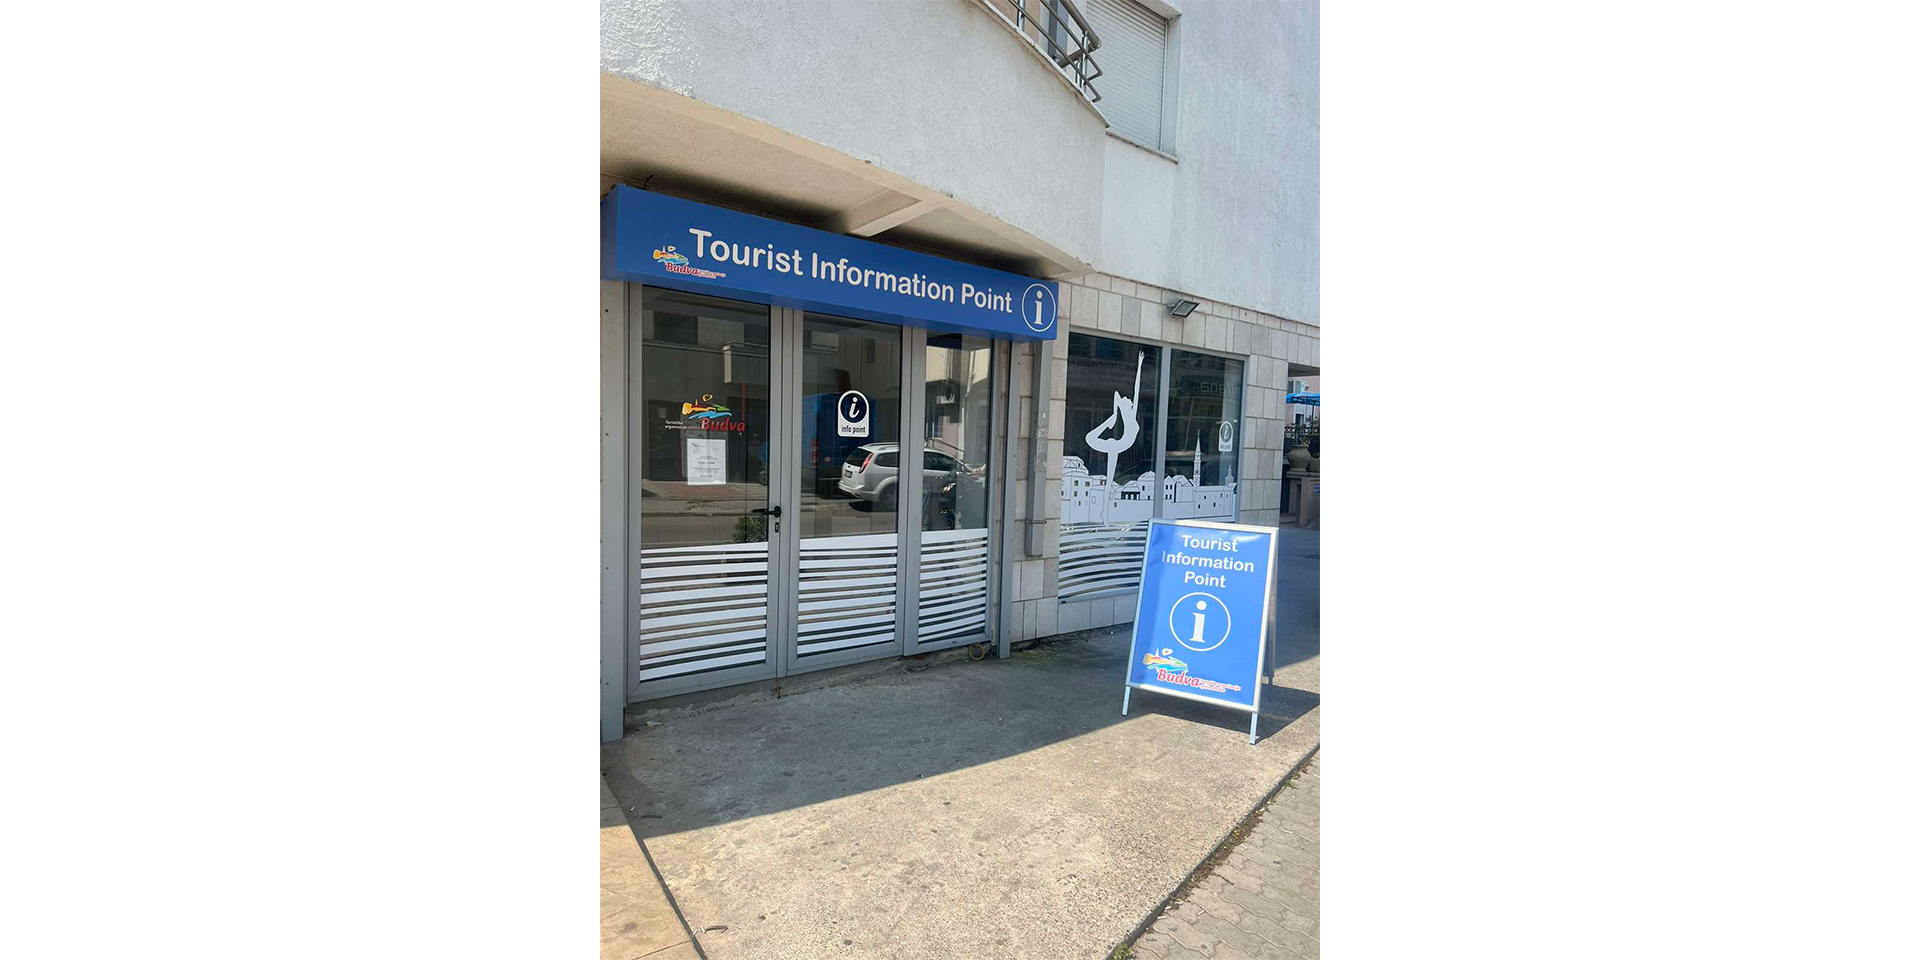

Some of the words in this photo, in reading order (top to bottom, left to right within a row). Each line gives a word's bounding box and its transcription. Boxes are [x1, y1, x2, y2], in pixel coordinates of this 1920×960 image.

[665, 261, 699, 277] Budva
[688, 227, 804, 276] Tourist
[811, 252, 954, 303] Information
[961, 283, 1013, 314] Point
[700, 416, 746, 433] Budva
[841, 424, 852, 433] info
[852, 425, 866, 435] point
[1181, 534, 1239, 553] Tourist
[1161, 550, 1254, 573] Information
[1184, 571, 1227, 588] Point
[1157, 669, 1200, 687] Budva
